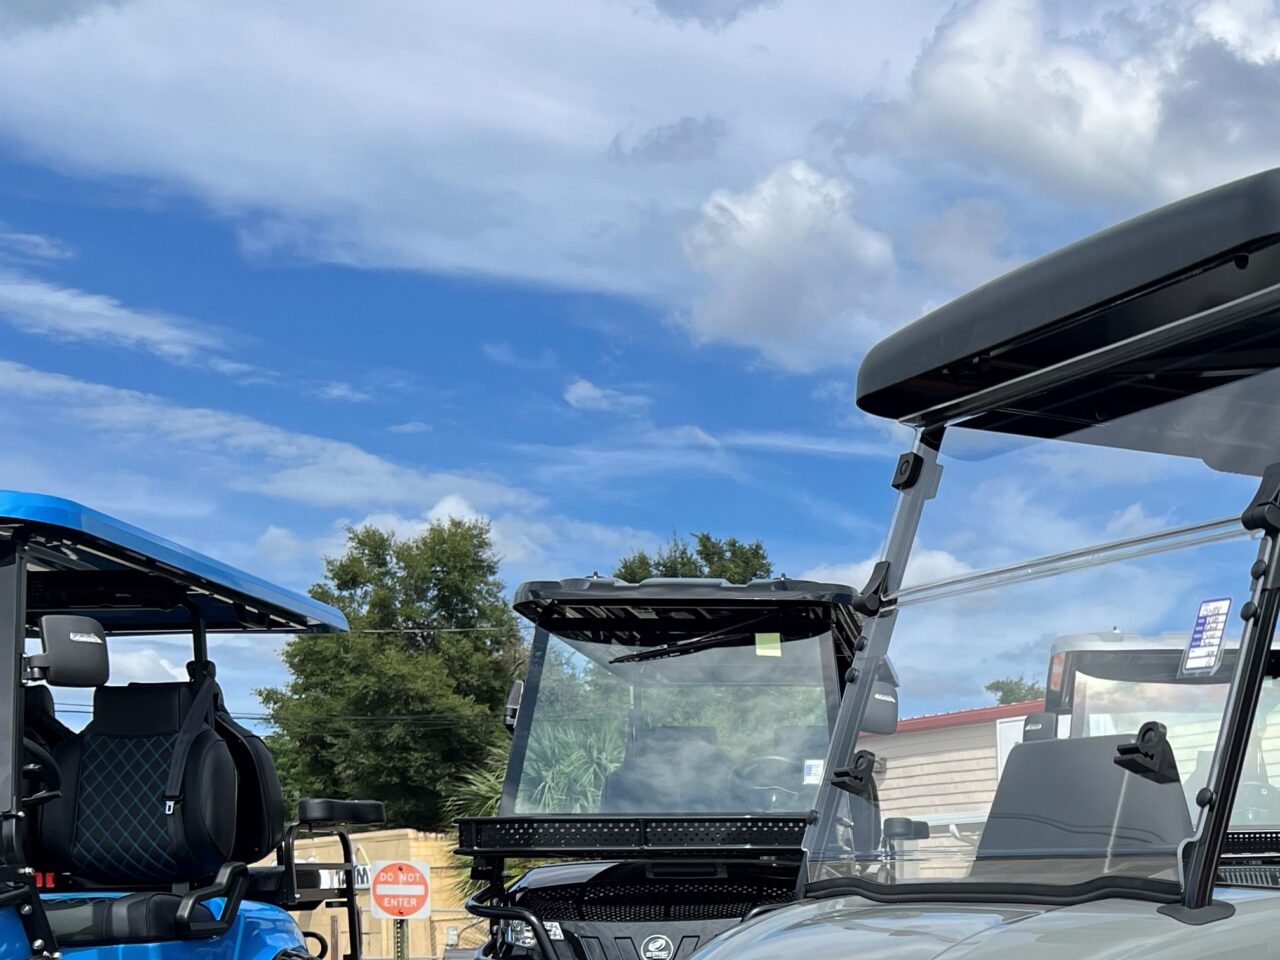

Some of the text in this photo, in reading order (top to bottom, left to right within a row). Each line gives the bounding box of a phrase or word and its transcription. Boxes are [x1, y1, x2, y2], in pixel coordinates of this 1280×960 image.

[380, 873, 420, 882] DO NOT
[384, 898, 417, 907] ENTER
